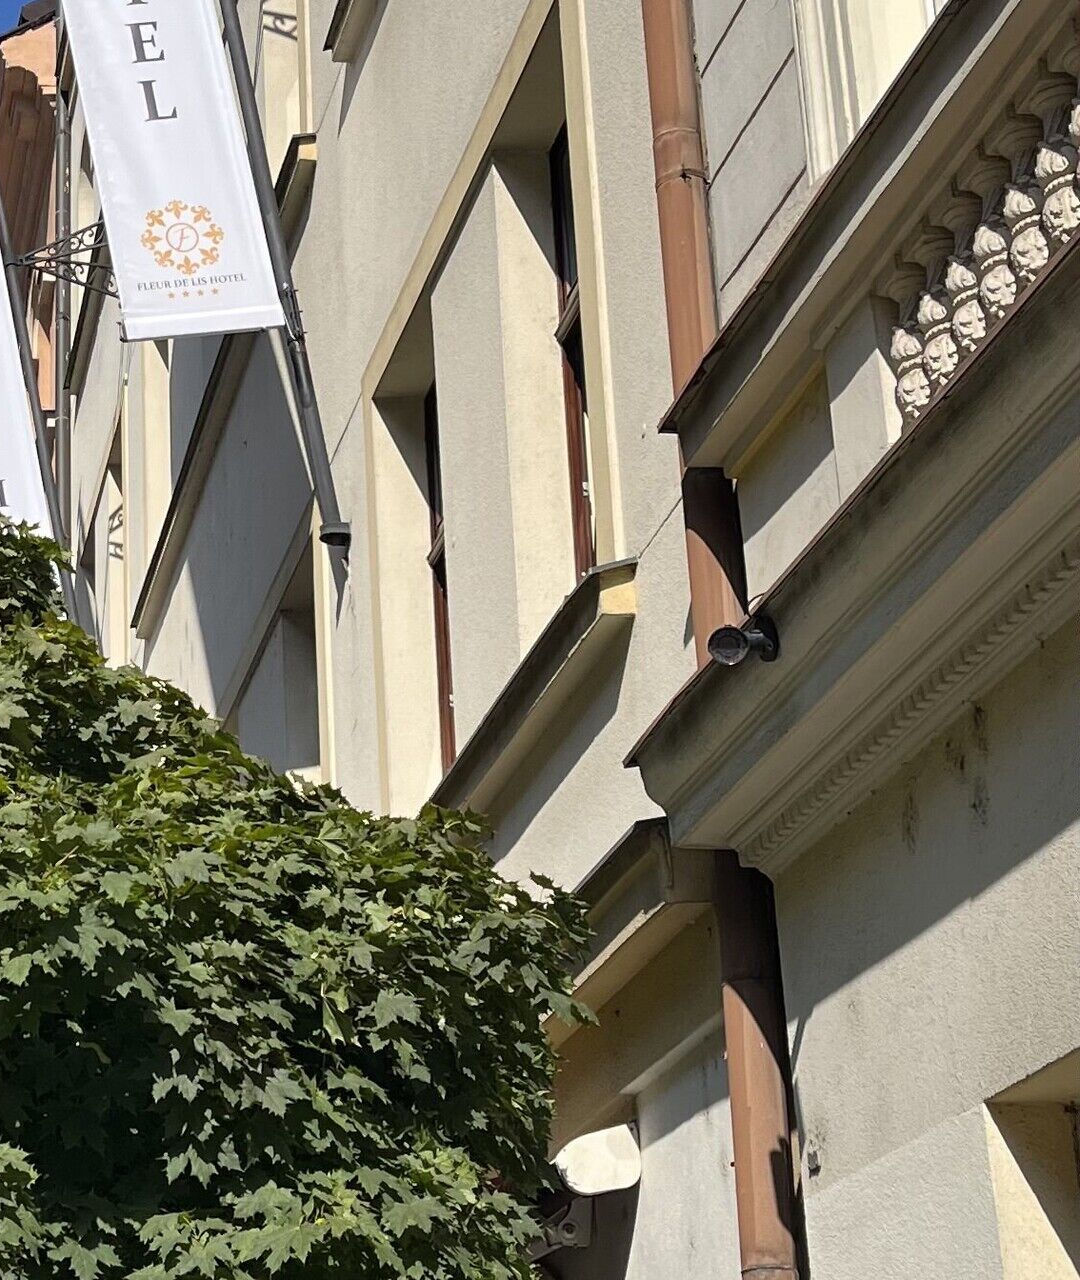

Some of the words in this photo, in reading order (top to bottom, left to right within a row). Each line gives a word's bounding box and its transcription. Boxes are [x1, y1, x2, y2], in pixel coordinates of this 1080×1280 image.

[137, 281, 172, 292] FLEUR
[174, 279, 190, 288] DE
[191, 276, 208, 287] LIS
[209, 272, 247, 285] HOTEL
